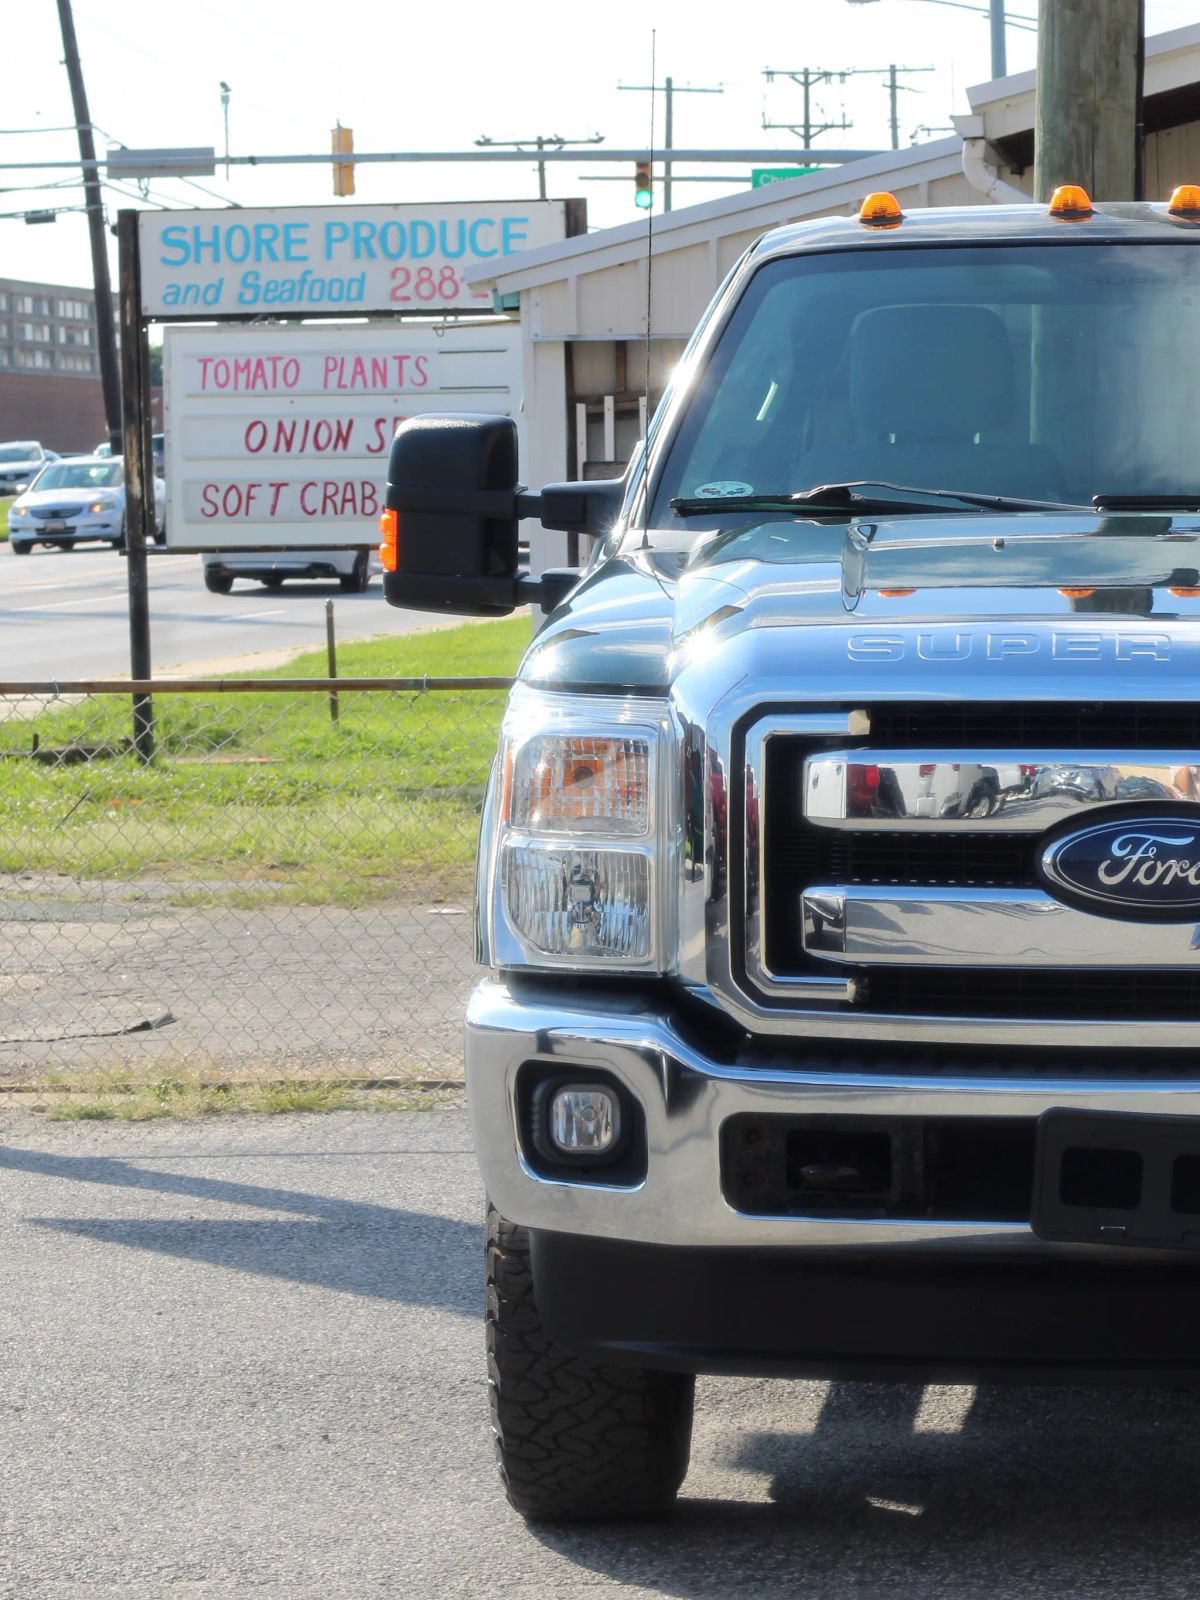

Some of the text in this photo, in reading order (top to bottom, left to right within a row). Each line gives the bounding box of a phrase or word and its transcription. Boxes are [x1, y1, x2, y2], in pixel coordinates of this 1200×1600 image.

[160, 217, 530, 267] SHORE PRODUCE
[163, 265, 489, 306] and Seafood 288
[197, 354, 430, 391] TOMATO PLANTS
[245, 418, 353, 453] ONION
[201, 480, 386, 518] SOFT CRAB
[847, 632, 1173, 662] SUPER
